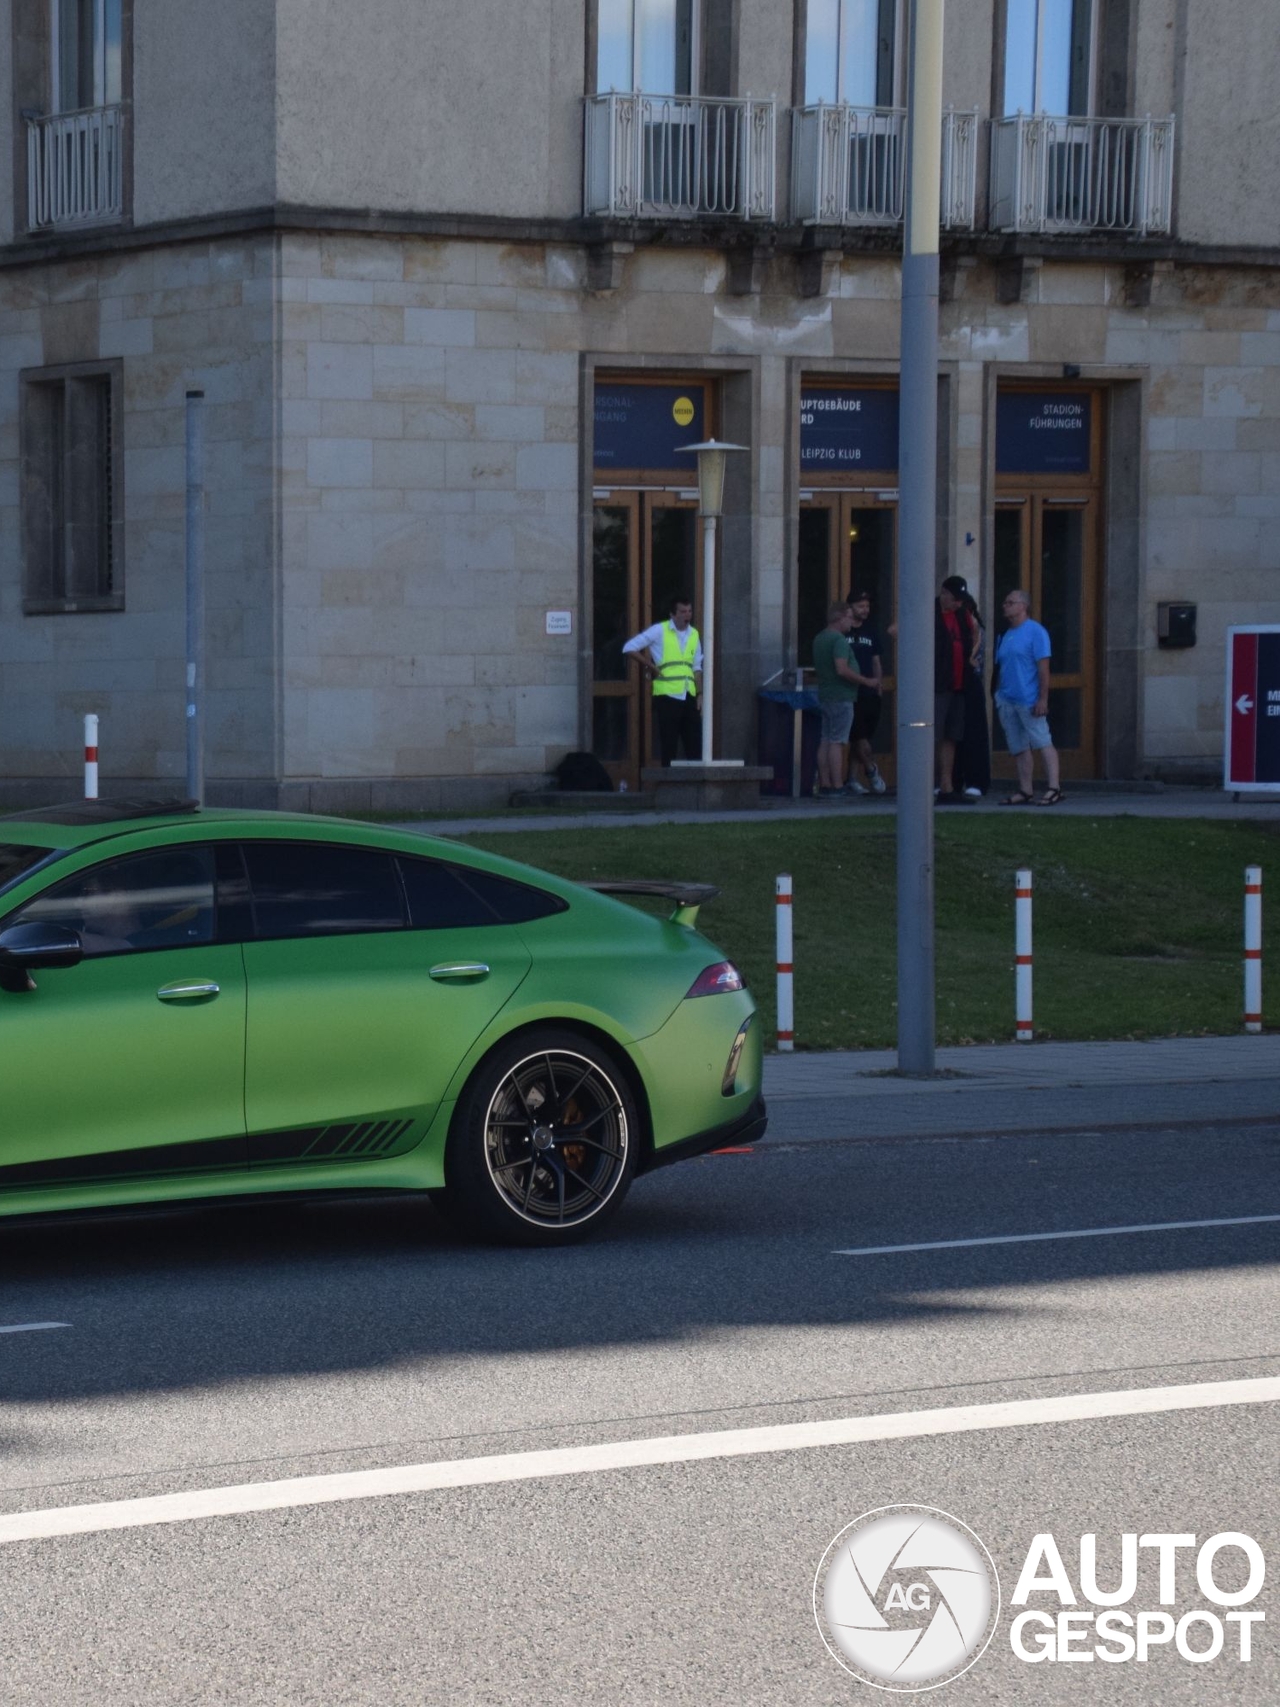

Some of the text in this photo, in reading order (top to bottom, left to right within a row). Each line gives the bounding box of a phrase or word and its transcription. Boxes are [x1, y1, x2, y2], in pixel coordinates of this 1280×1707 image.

[1043, 404, 1085, 415] STADION-
[1029, 416, 1083, 429] FÜHRUNGEN
[801, 448, 862, 460] LEIPZIG KLUB
